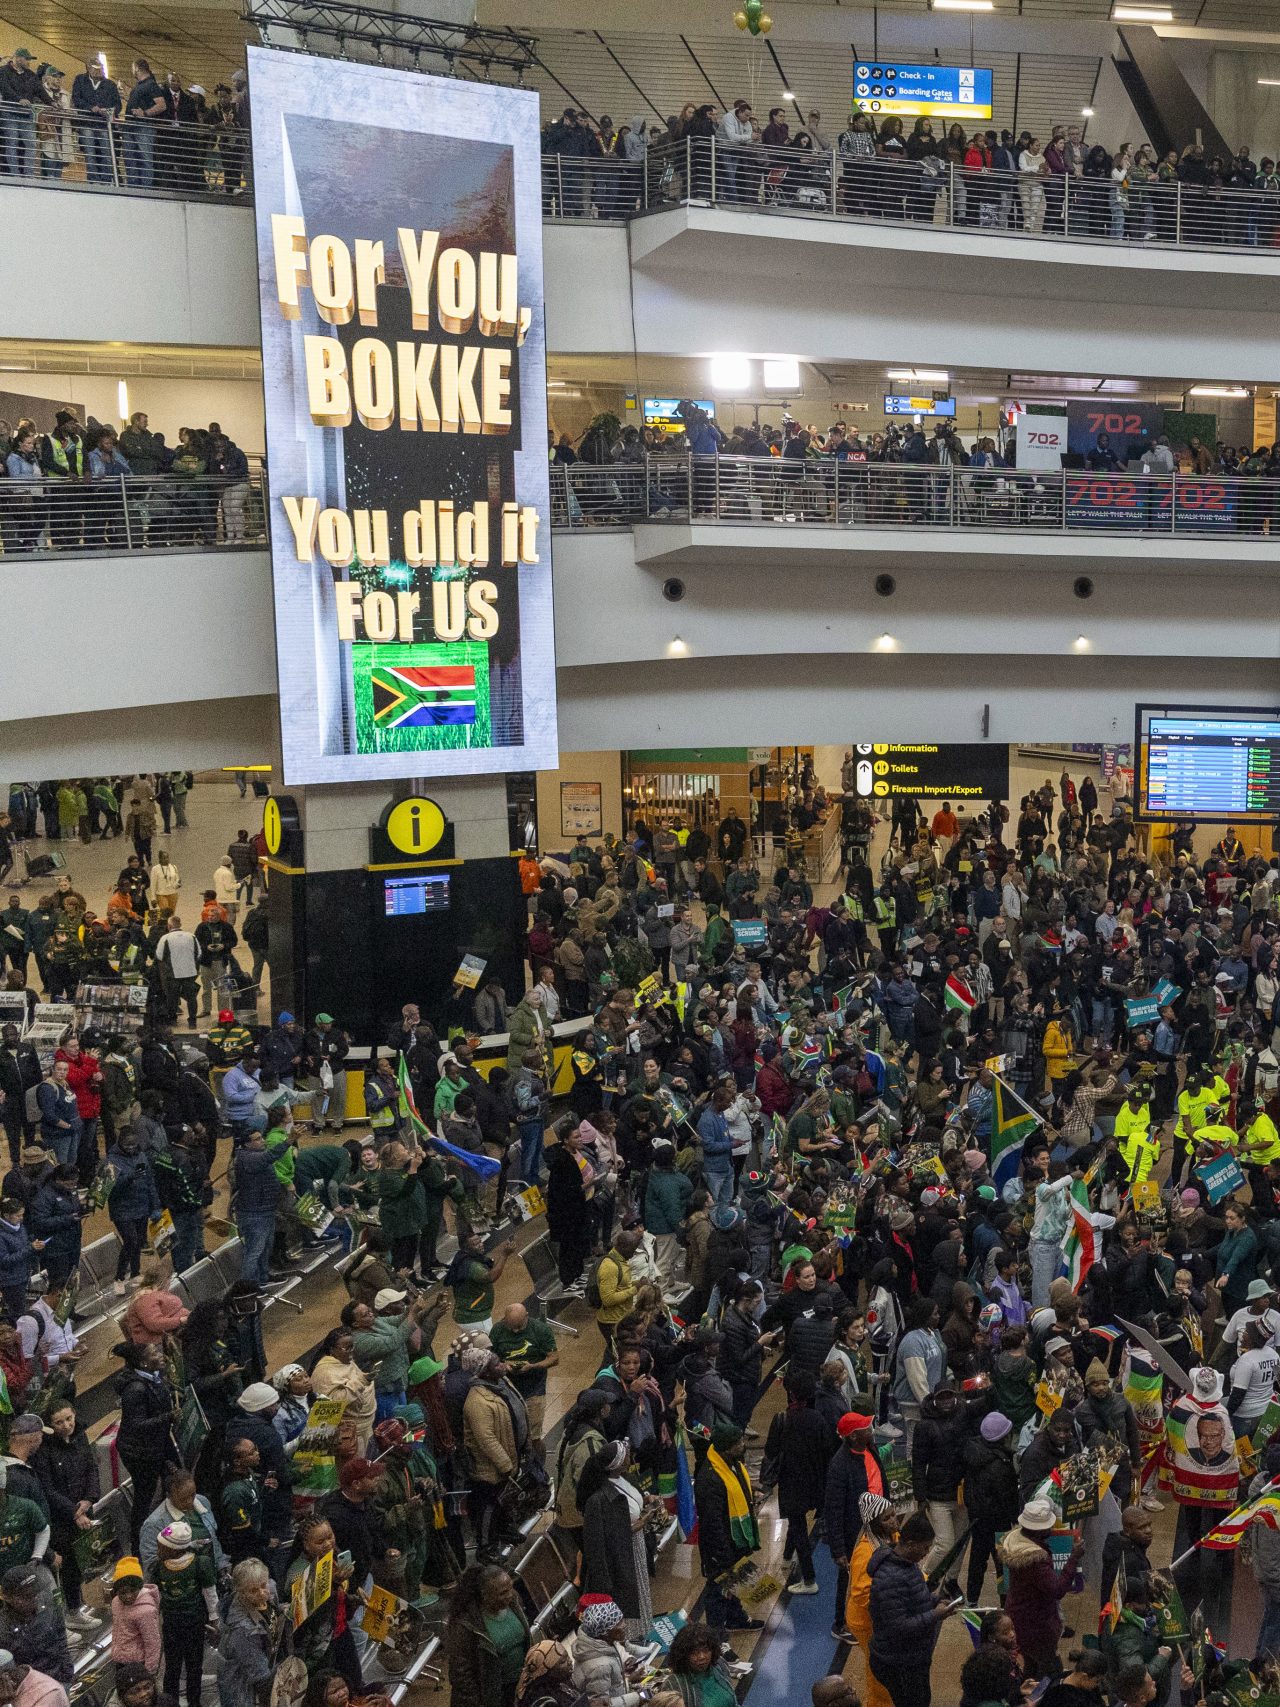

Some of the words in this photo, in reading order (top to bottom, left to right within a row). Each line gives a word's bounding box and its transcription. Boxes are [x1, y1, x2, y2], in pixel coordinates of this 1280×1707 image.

[899, 71, 922, 80] Check
[898, 87, 931, 97] Boarding
[932, 89, 953, 97] Gates
[271, 214, 386, 327] For
[397, 228, 532, 348] You,
[304, 335, 513, 435] BOKKE
[1125, 511, 1143, 519] TALK
[1177, 513, 1198, 521] WALK
[282, 496, 391, 568] You
[403, 500, 490, 568] did
[501, 502, 540, 568] it
[335, 581, 421, 642] For
[432, 580, 499, 642] US
[889, 744, 938, 753] Information
[891, 764, 919, 773] Toilets
[891, 785, 924, 794] Firearm
[924, 785, 983, 796] Import/Export
[1205, 1175, 1214, 1185] OUR
[1213, 1167, 1228, 1180] HEARTS
[1227, 1162, 1236, 1171] ARE
[1207, 1178, 1224, 1191] GREEN
[1226, 1167, 1238, 1179] GOLD
[314, 1407, 341, 1417] BOKKE
[653, 1620, 673, 1646] SCRUMS
